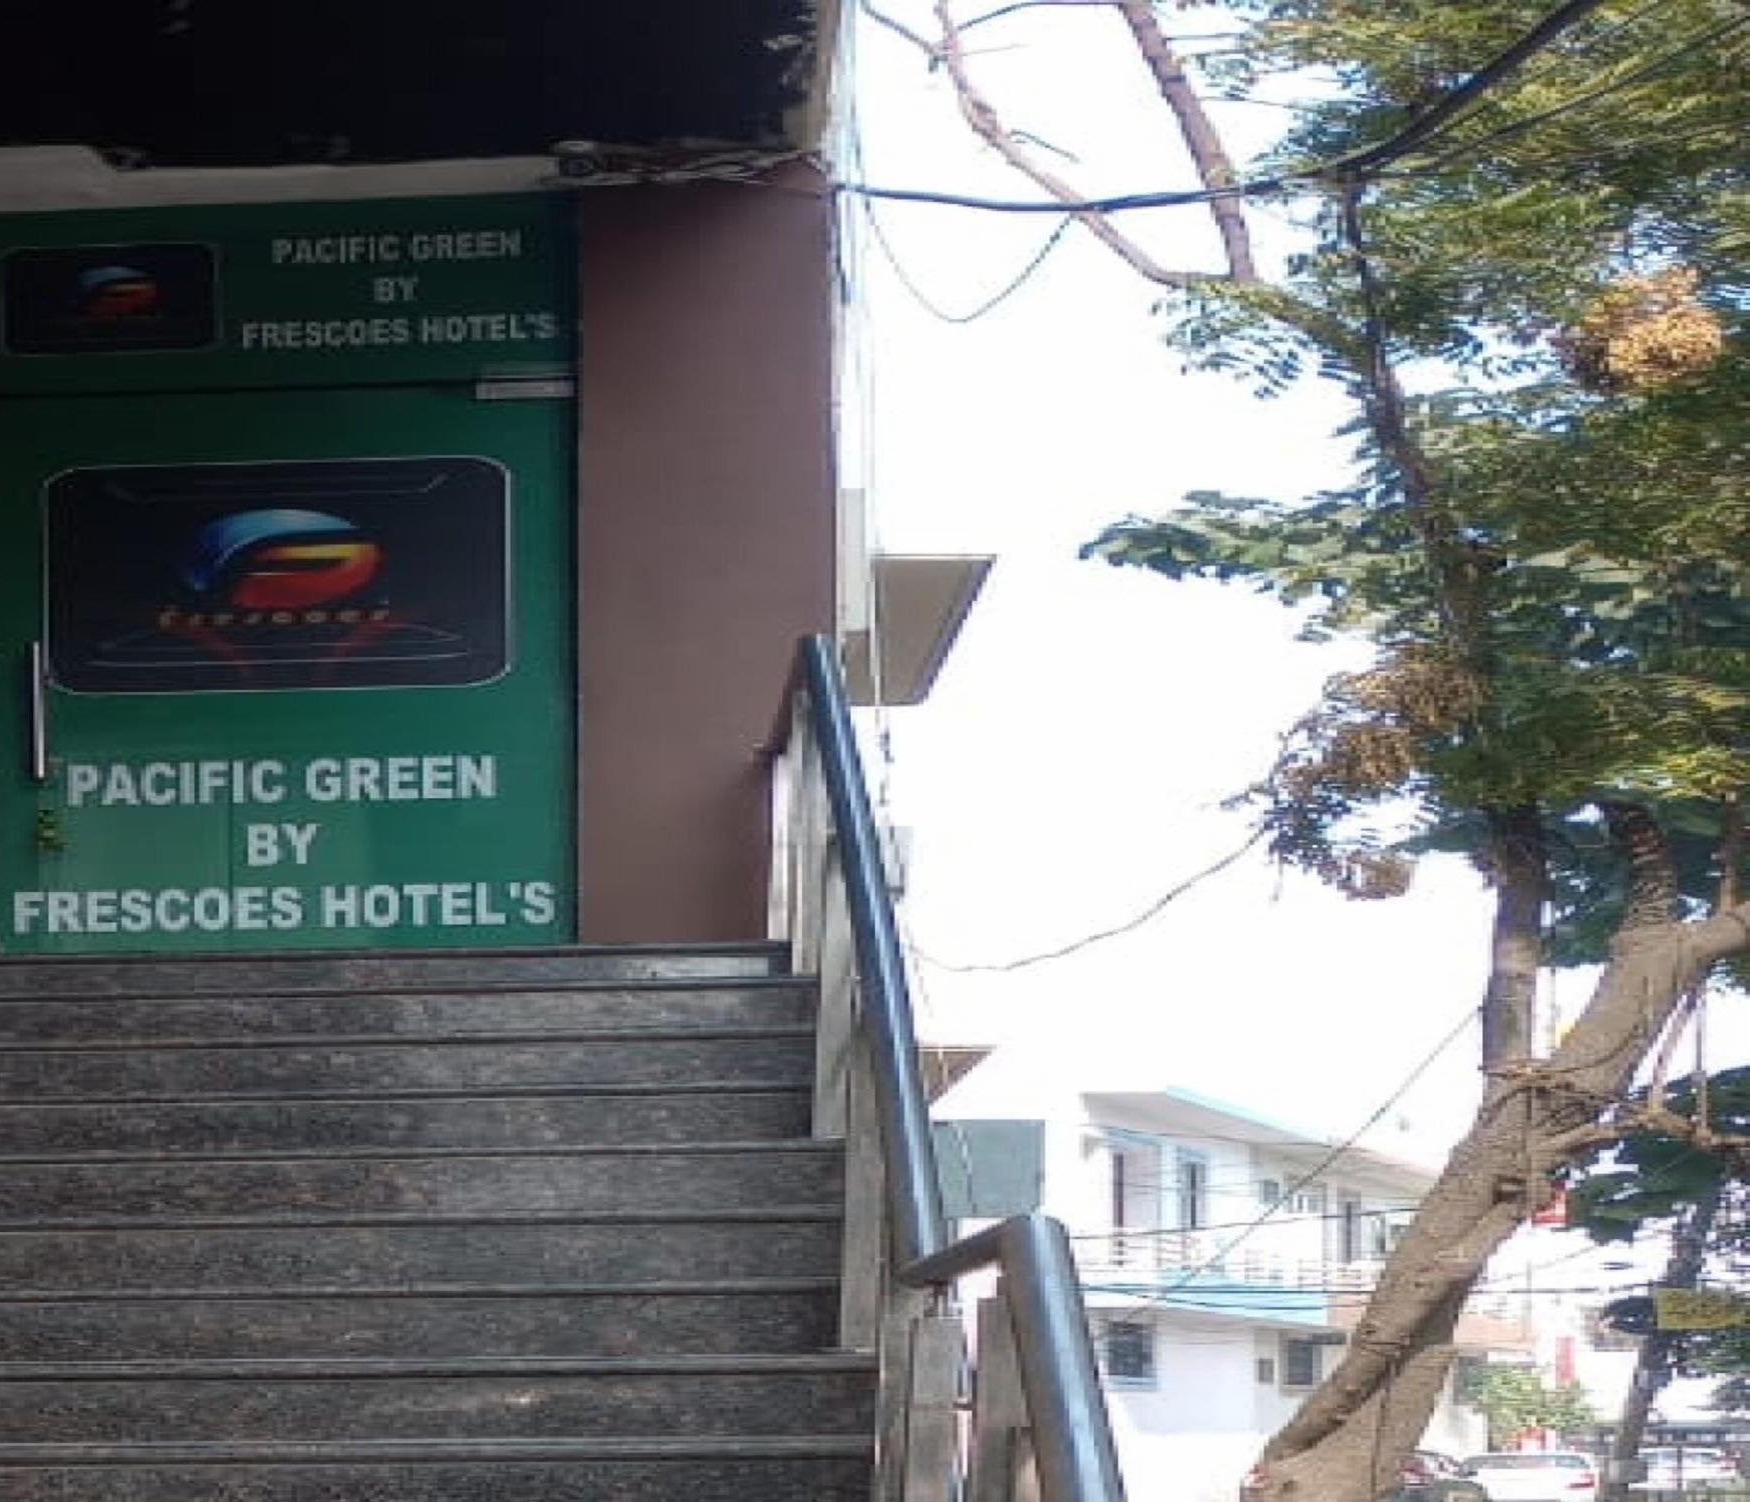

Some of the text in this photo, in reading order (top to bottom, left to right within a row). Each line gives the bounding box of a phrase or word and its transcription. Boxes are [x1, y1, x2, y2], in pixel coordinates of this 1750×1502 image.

[271, 230, 522, 263] PACIFIC GREEN
[373, 276, 418, 302] BY
[242, 313, 556, 349] FRESCOES HOTEL'S
[66, 755, 497, 806] PACIFIC GREEN
[246, 823, 320, 867] BY
[12, 881, 556, 934] FRESCOES HOTEL'S
